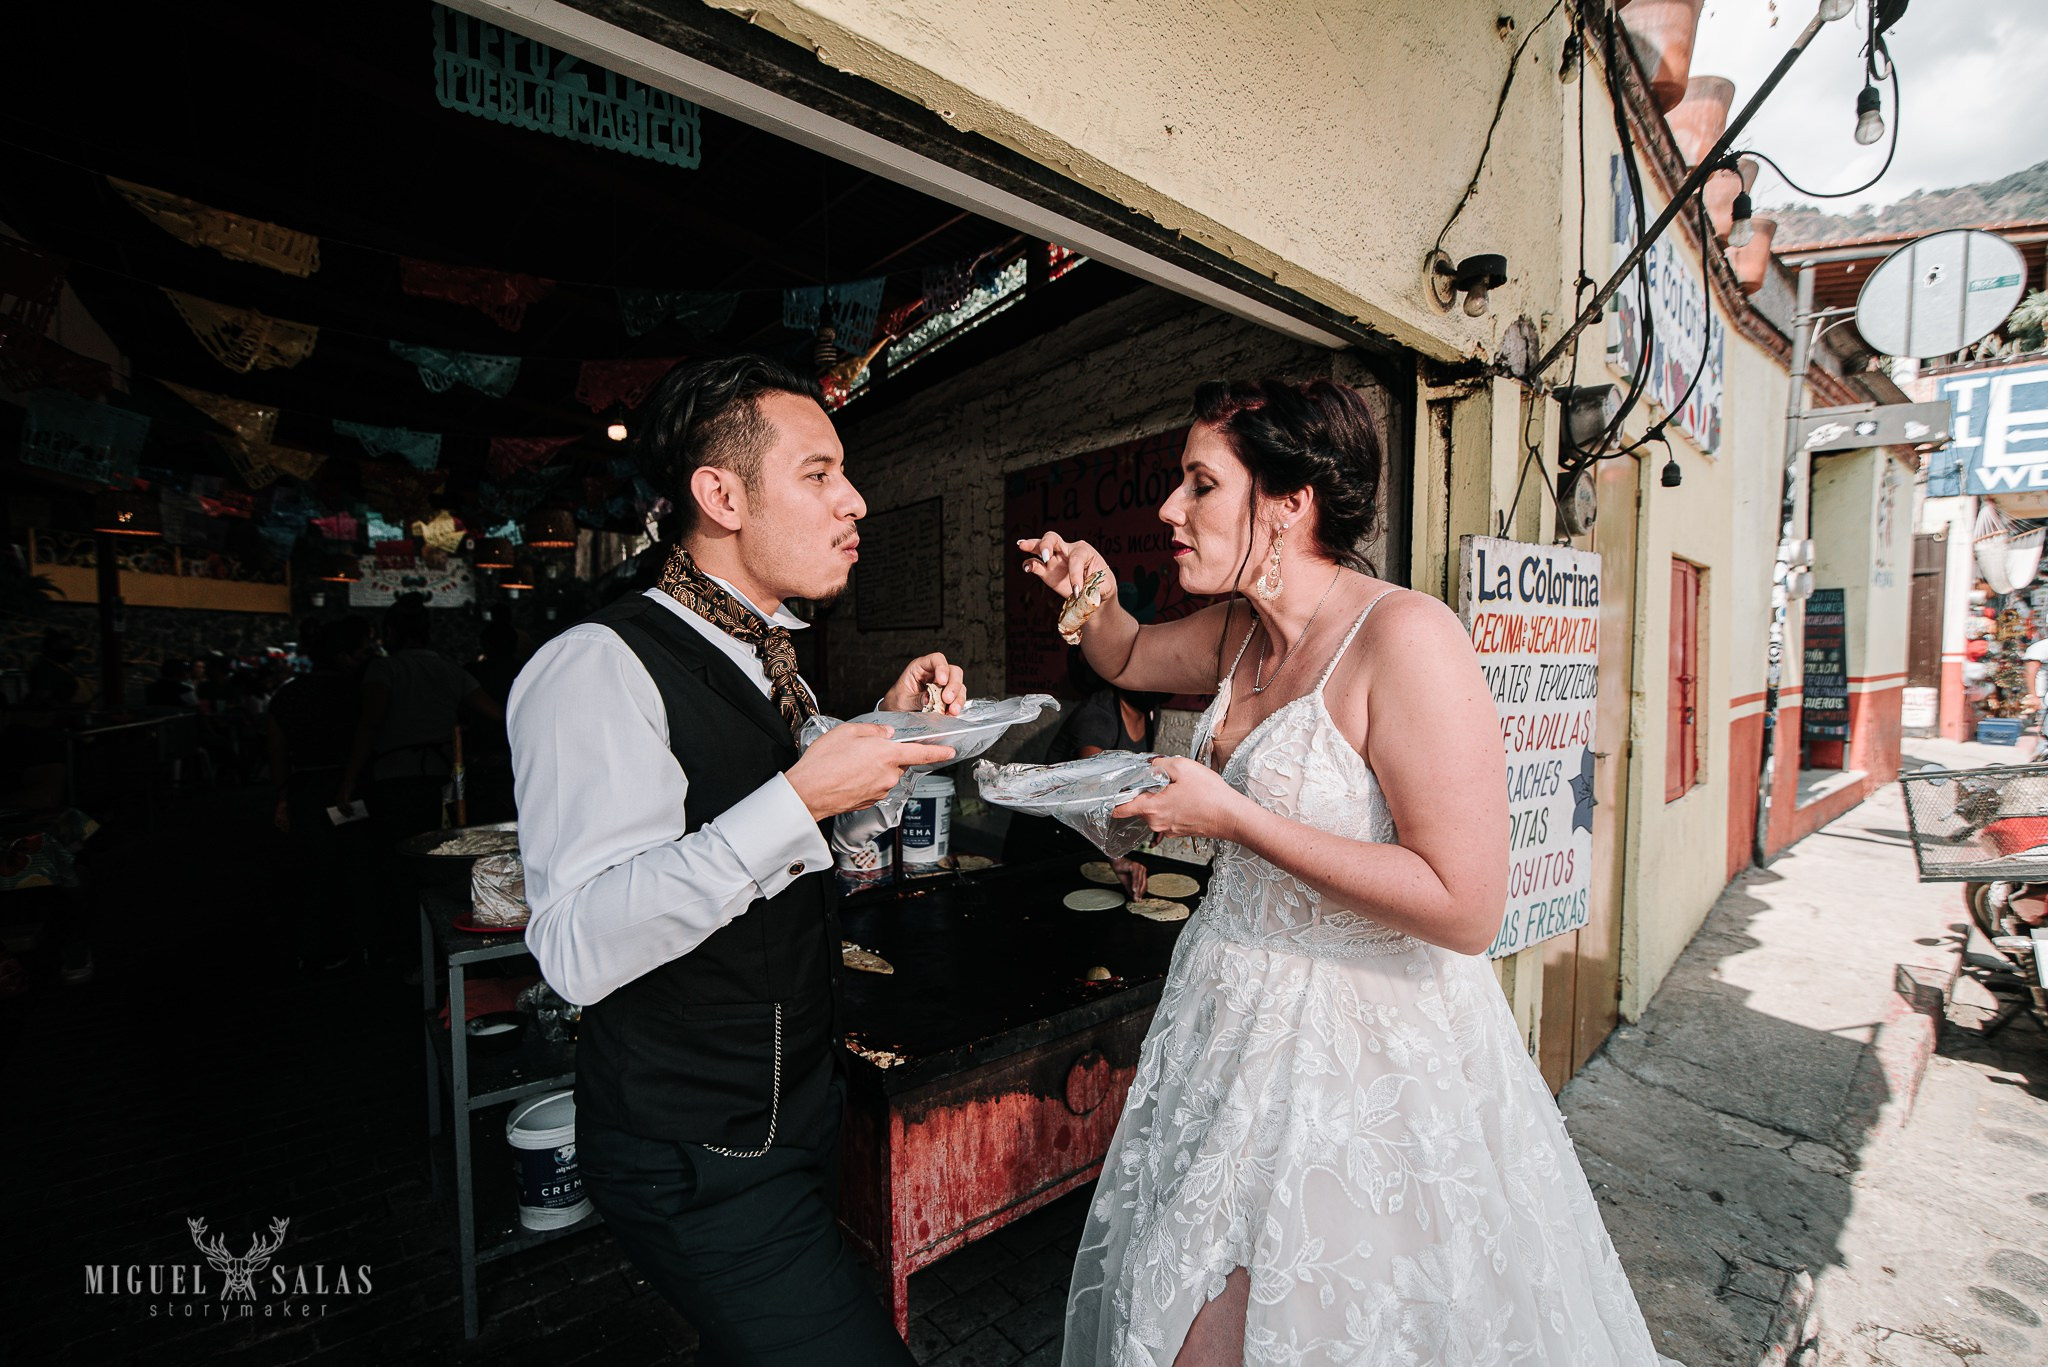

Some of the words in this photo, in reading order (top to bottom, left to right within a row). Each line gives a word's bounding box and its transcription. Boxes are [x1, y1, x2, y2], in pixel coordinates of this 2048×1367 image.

[447, 60, 551, 126] PUEBLO
[570, 89, 693, 157] MAGICO
[1094, 452, 1181, 517] Color
[1477, 549, 1512, 604] La
[1519, 556, 1599, 608] Colorina
[1472, 613, 1523, 654] CECINA
[1528, 616, 1597, 654] YECAPIXTLA
[1535, 664, 1598, 703] TEPOZTECOS
[1803, 697, 1845, 709] SUEROS
[1506, 760, 1562, 803] RACHES
[903, 829, 932, 837] REMA
[1507, 848, 1574, 899] OYITOS
[1486, 909, 1520, 956] UAS
[1525, 888, 1586, 943] FRESCAS
[541, 1178, 582, 1197] CREM
